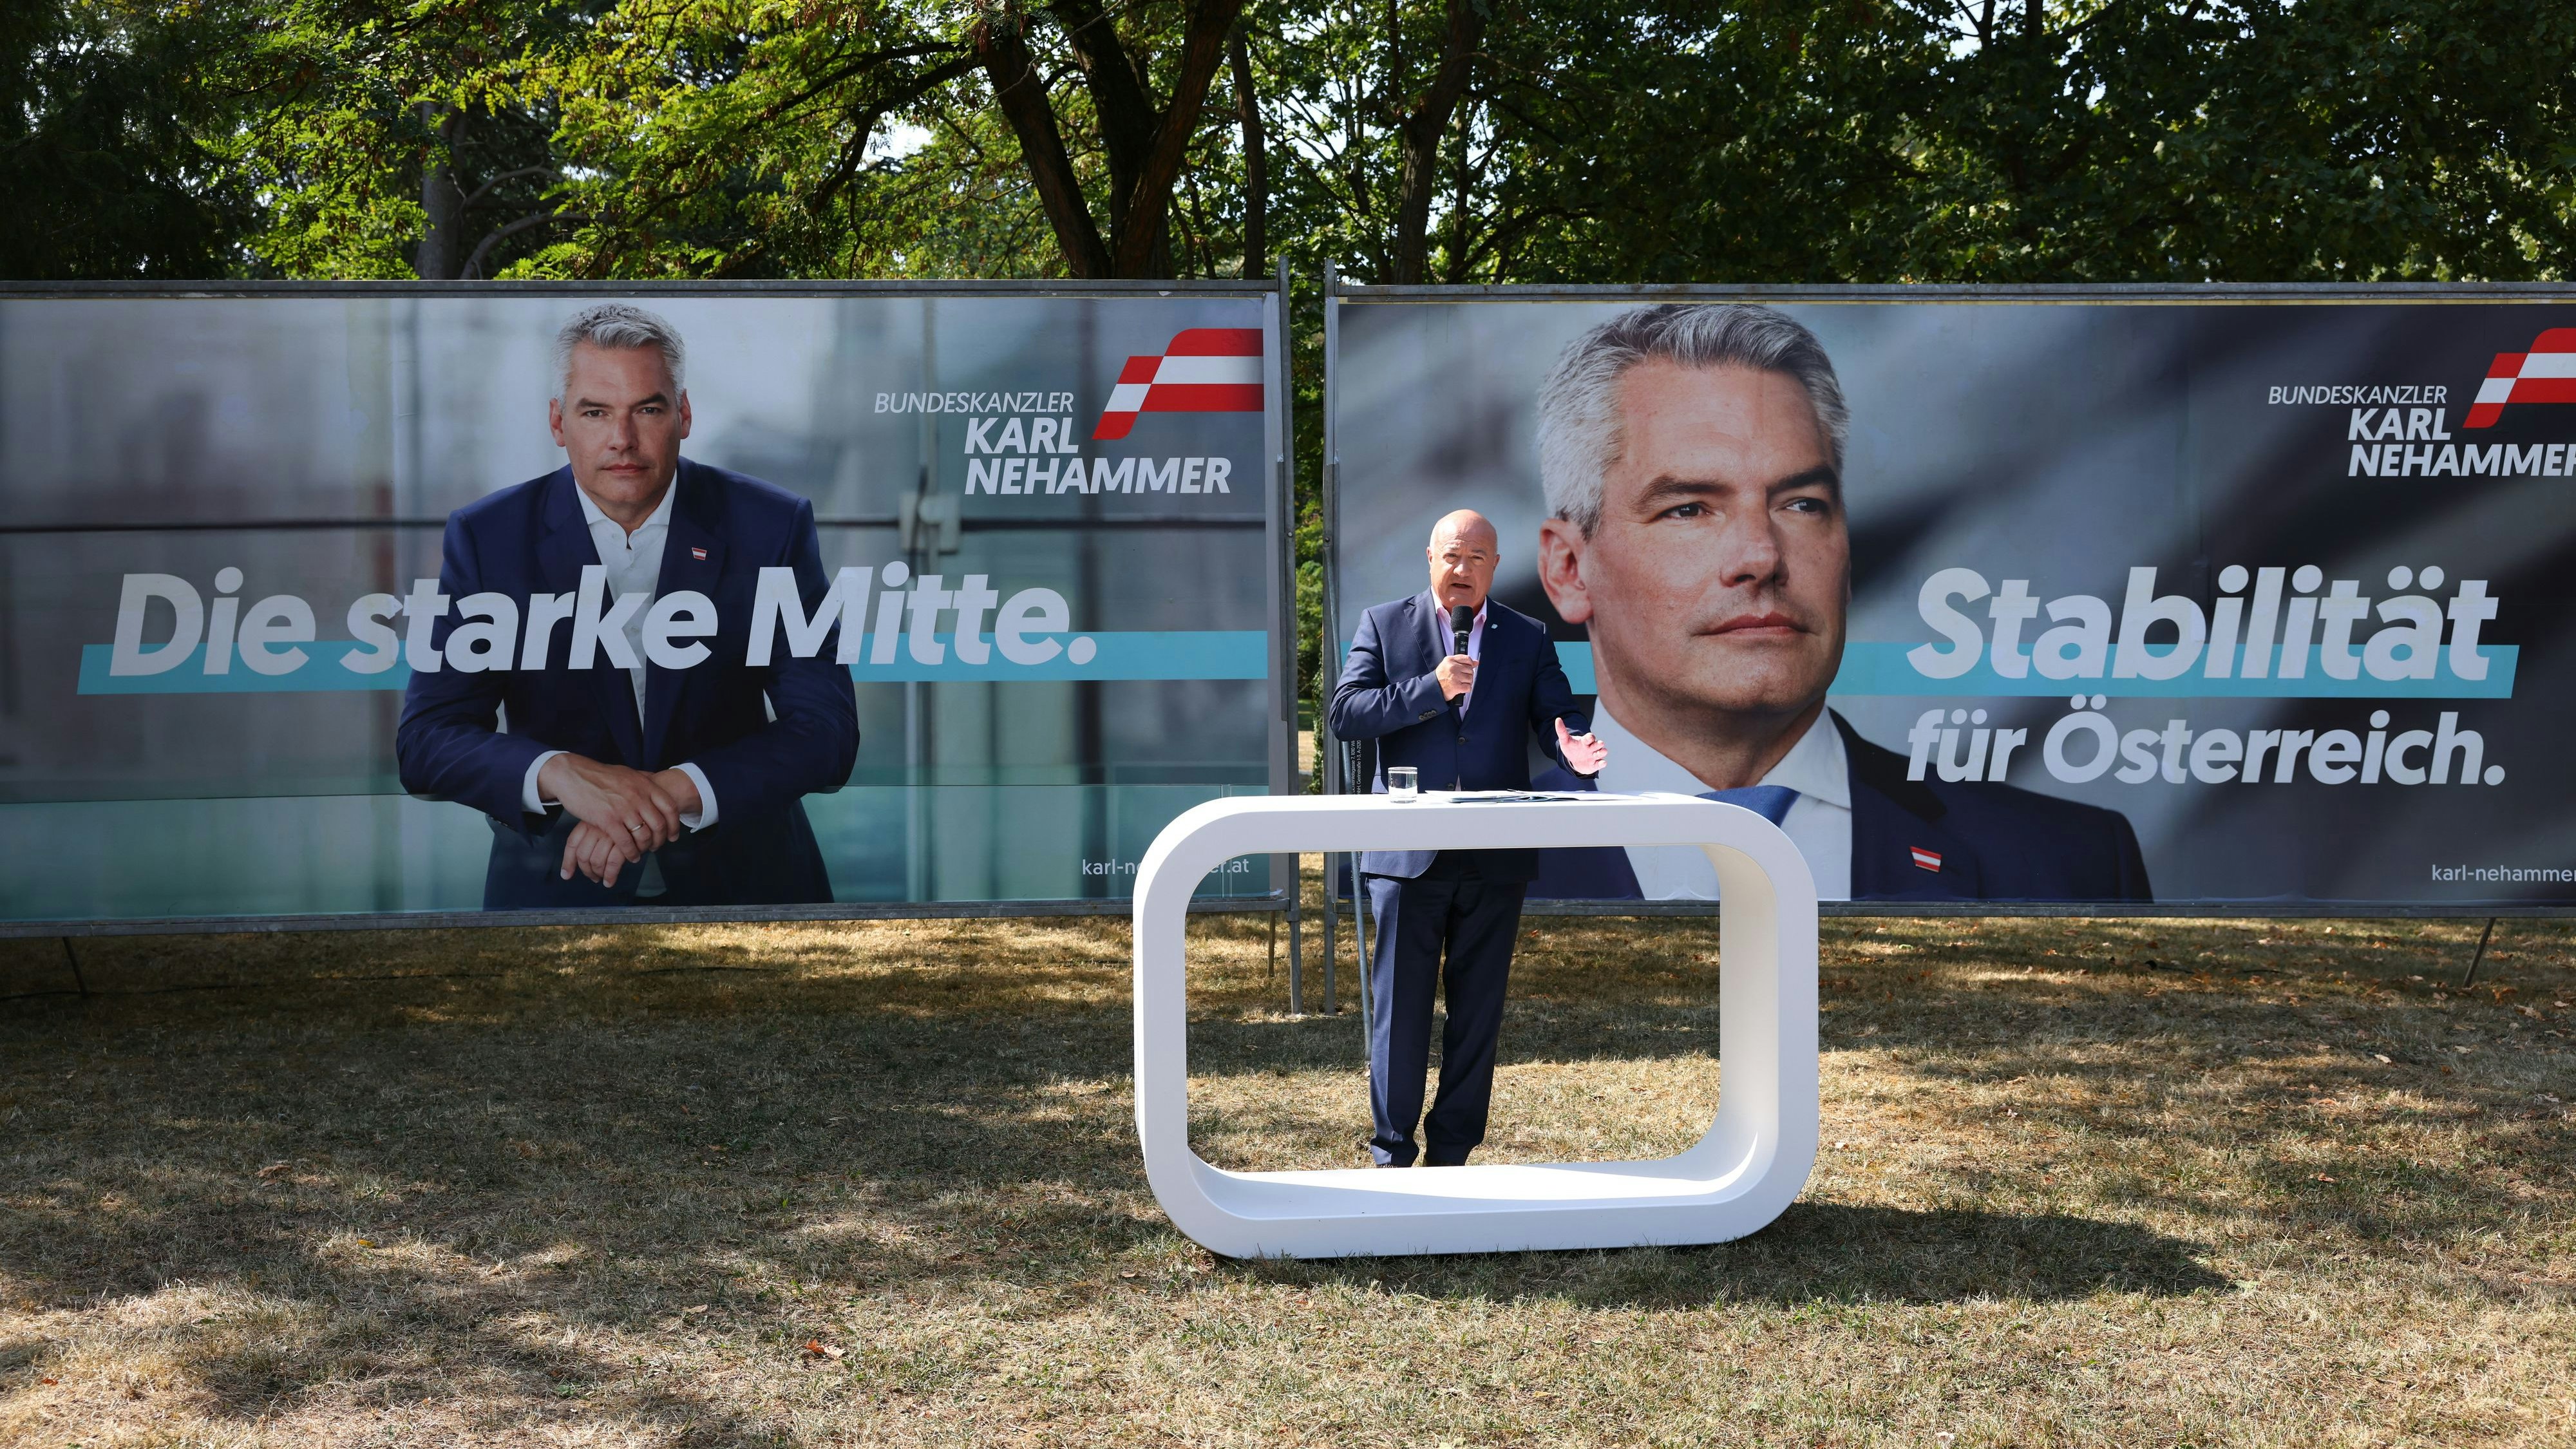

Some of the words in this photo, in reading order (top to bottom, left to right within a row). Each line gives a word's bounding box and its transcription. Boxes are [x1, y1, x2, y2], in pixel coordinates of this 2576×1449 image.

[874, 392, 1074, 413] BUNDESKANZLER
[2268, 385, 2447, 405] BUNDESKANZLER
[965, 417, 1079, 455] KARL
[2347, 408, 2452, 441] KARL
[965, 457, 1232, 495] NEHAMMER
[109, 566, 317, 677] Die
[339, 564, 719, 674] starke
[745, 560, 1097, 667] Mitte.
[1906, 564, 2499, 682] Stabilität
[1906, 708, 2027, 782] für
[2042, 693, 2506, 786] Österreich.
[2432, 864, 2576, 882] karl-nehamme
